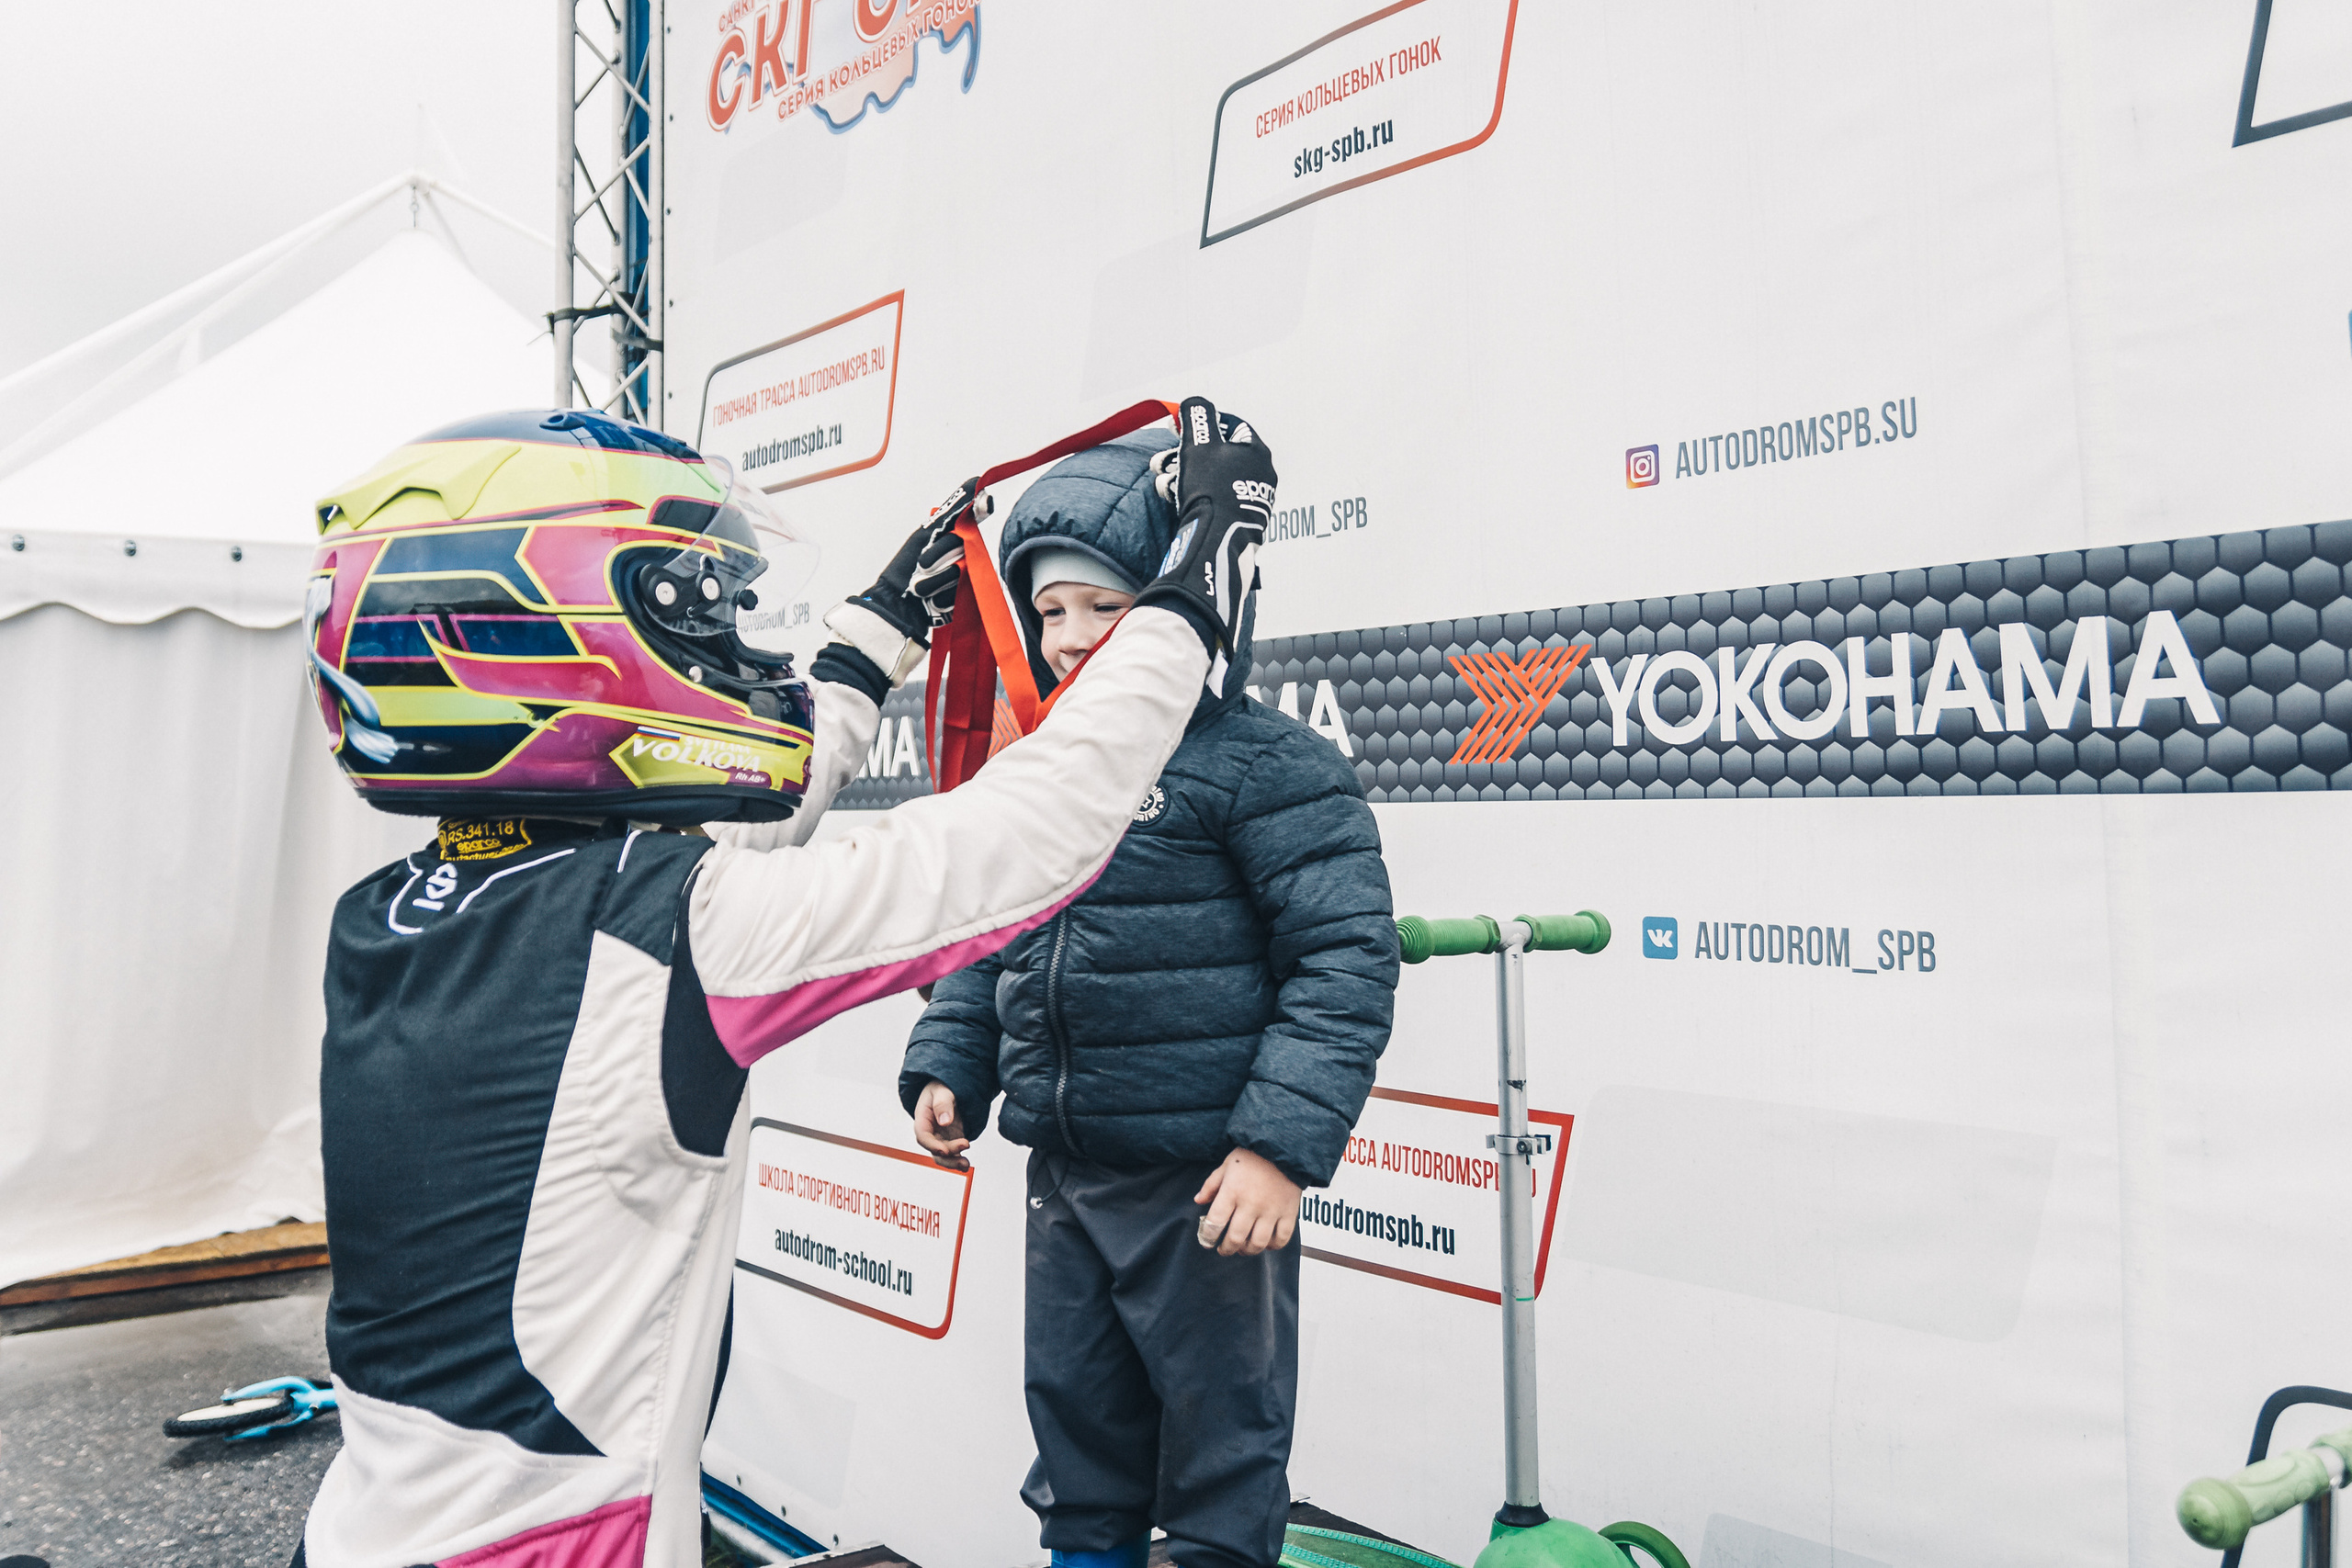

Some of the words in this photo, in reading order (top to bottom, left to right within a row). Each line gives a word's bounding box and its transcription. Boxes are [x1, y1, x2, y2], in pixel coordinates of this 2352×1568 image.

[778, 82, 823, 120] СЕРИЯ
[830, 20, 919, 90] КОЛЬЦЕВЫХ
[923, 0, 979, 34] ГОНО
[1256, 99, 1294, 139] СЕРИЯ
[1297, 57, 1385, 118] КОЛЬЦЕВЫХ
[1389, 36, 1442, 81] ГОНОК
[1294, 119, 1394, 178] skg-spb.ru
[713, 392, 757, 428] ГОНОЧНАЯ
[760, 379, 796, 412] ТРАССА
[797, 345, 886, 400] AUTODROMSPB.RU
[742, 423, 842, 472] autodromspb.ru
[1675, 396, 1918, 479] AUTODROMSPB.SU
[1232, 479, 1275, 502] sparc
[1590, 610, 2222, 747] YOKOHAMA
[633, 739, 762, 773] VOLKOVA
[1694, 920, 1937, 975] AUTODROM_SPB
[758, 1162, 795, 1195] ШКОЛА
[797, 1173, 871, 1218] СПОРТИВНОГО
[874, 1194, 941, 1239] ВОЖДЕНИЯ
[1298, 1193, 1455, 1256] utodromspb.ru
[775, 1228, 912, 1297] autodrom-school.ru
